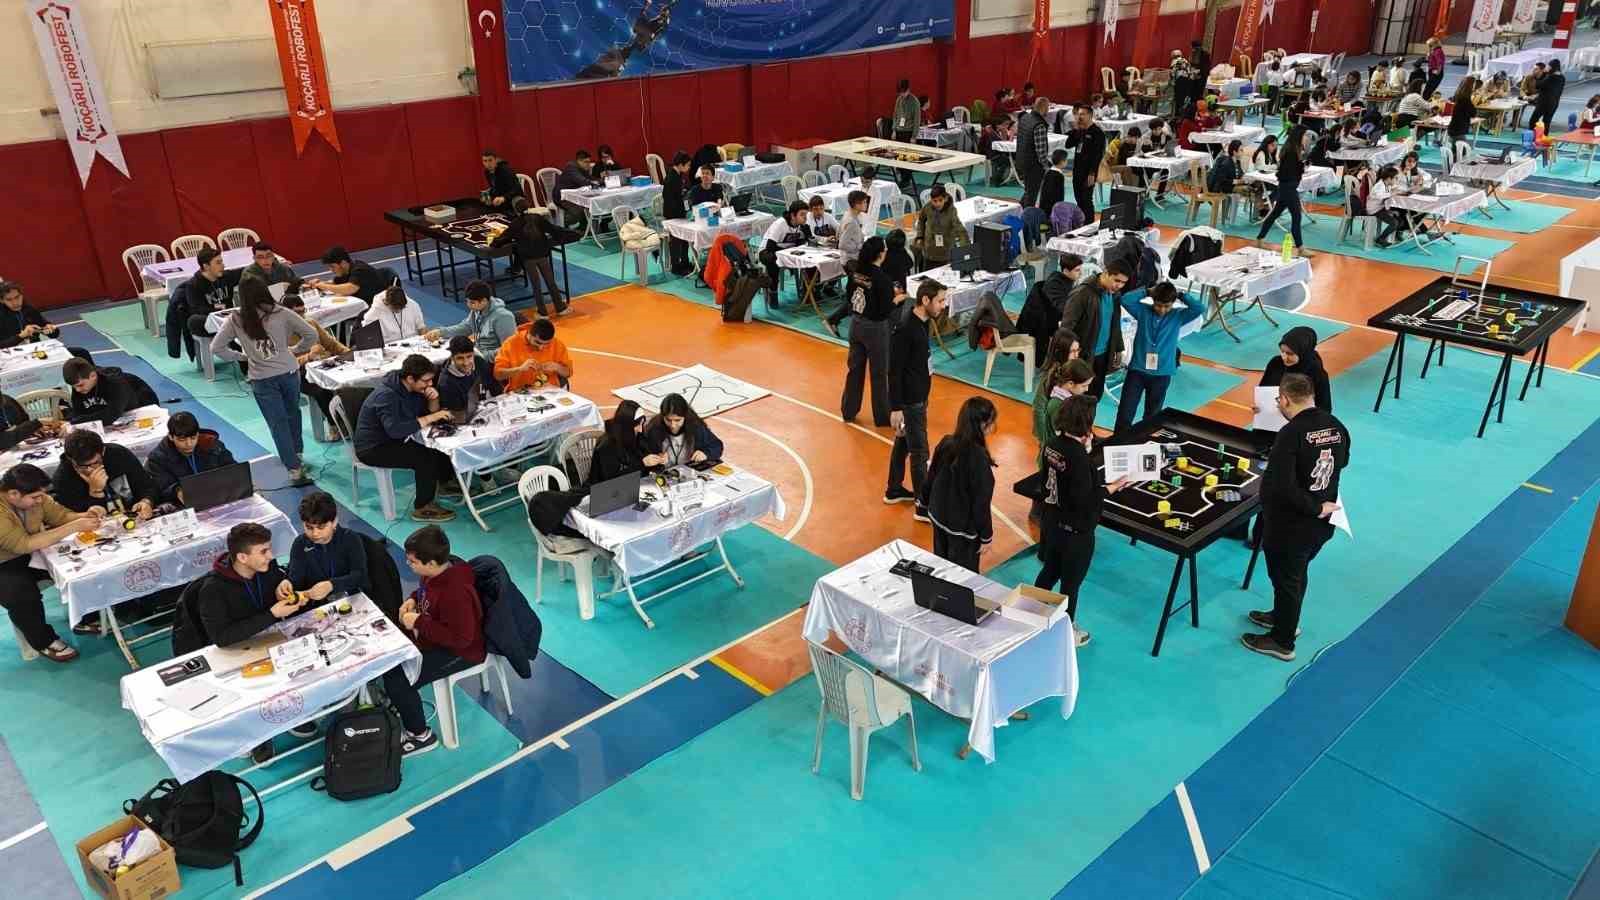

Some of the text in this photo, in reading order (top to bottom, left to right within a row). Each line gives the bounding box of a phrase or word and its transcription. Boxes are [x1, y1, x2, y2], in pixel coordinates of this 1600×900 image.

[51, 16, 80, 79] ROBOFEST
[288, 2, 307, 62] ROBOFEST
[72, 82, 96, 133] KOÇARLI
[299, 63, 317, 111] KOÇARLI
